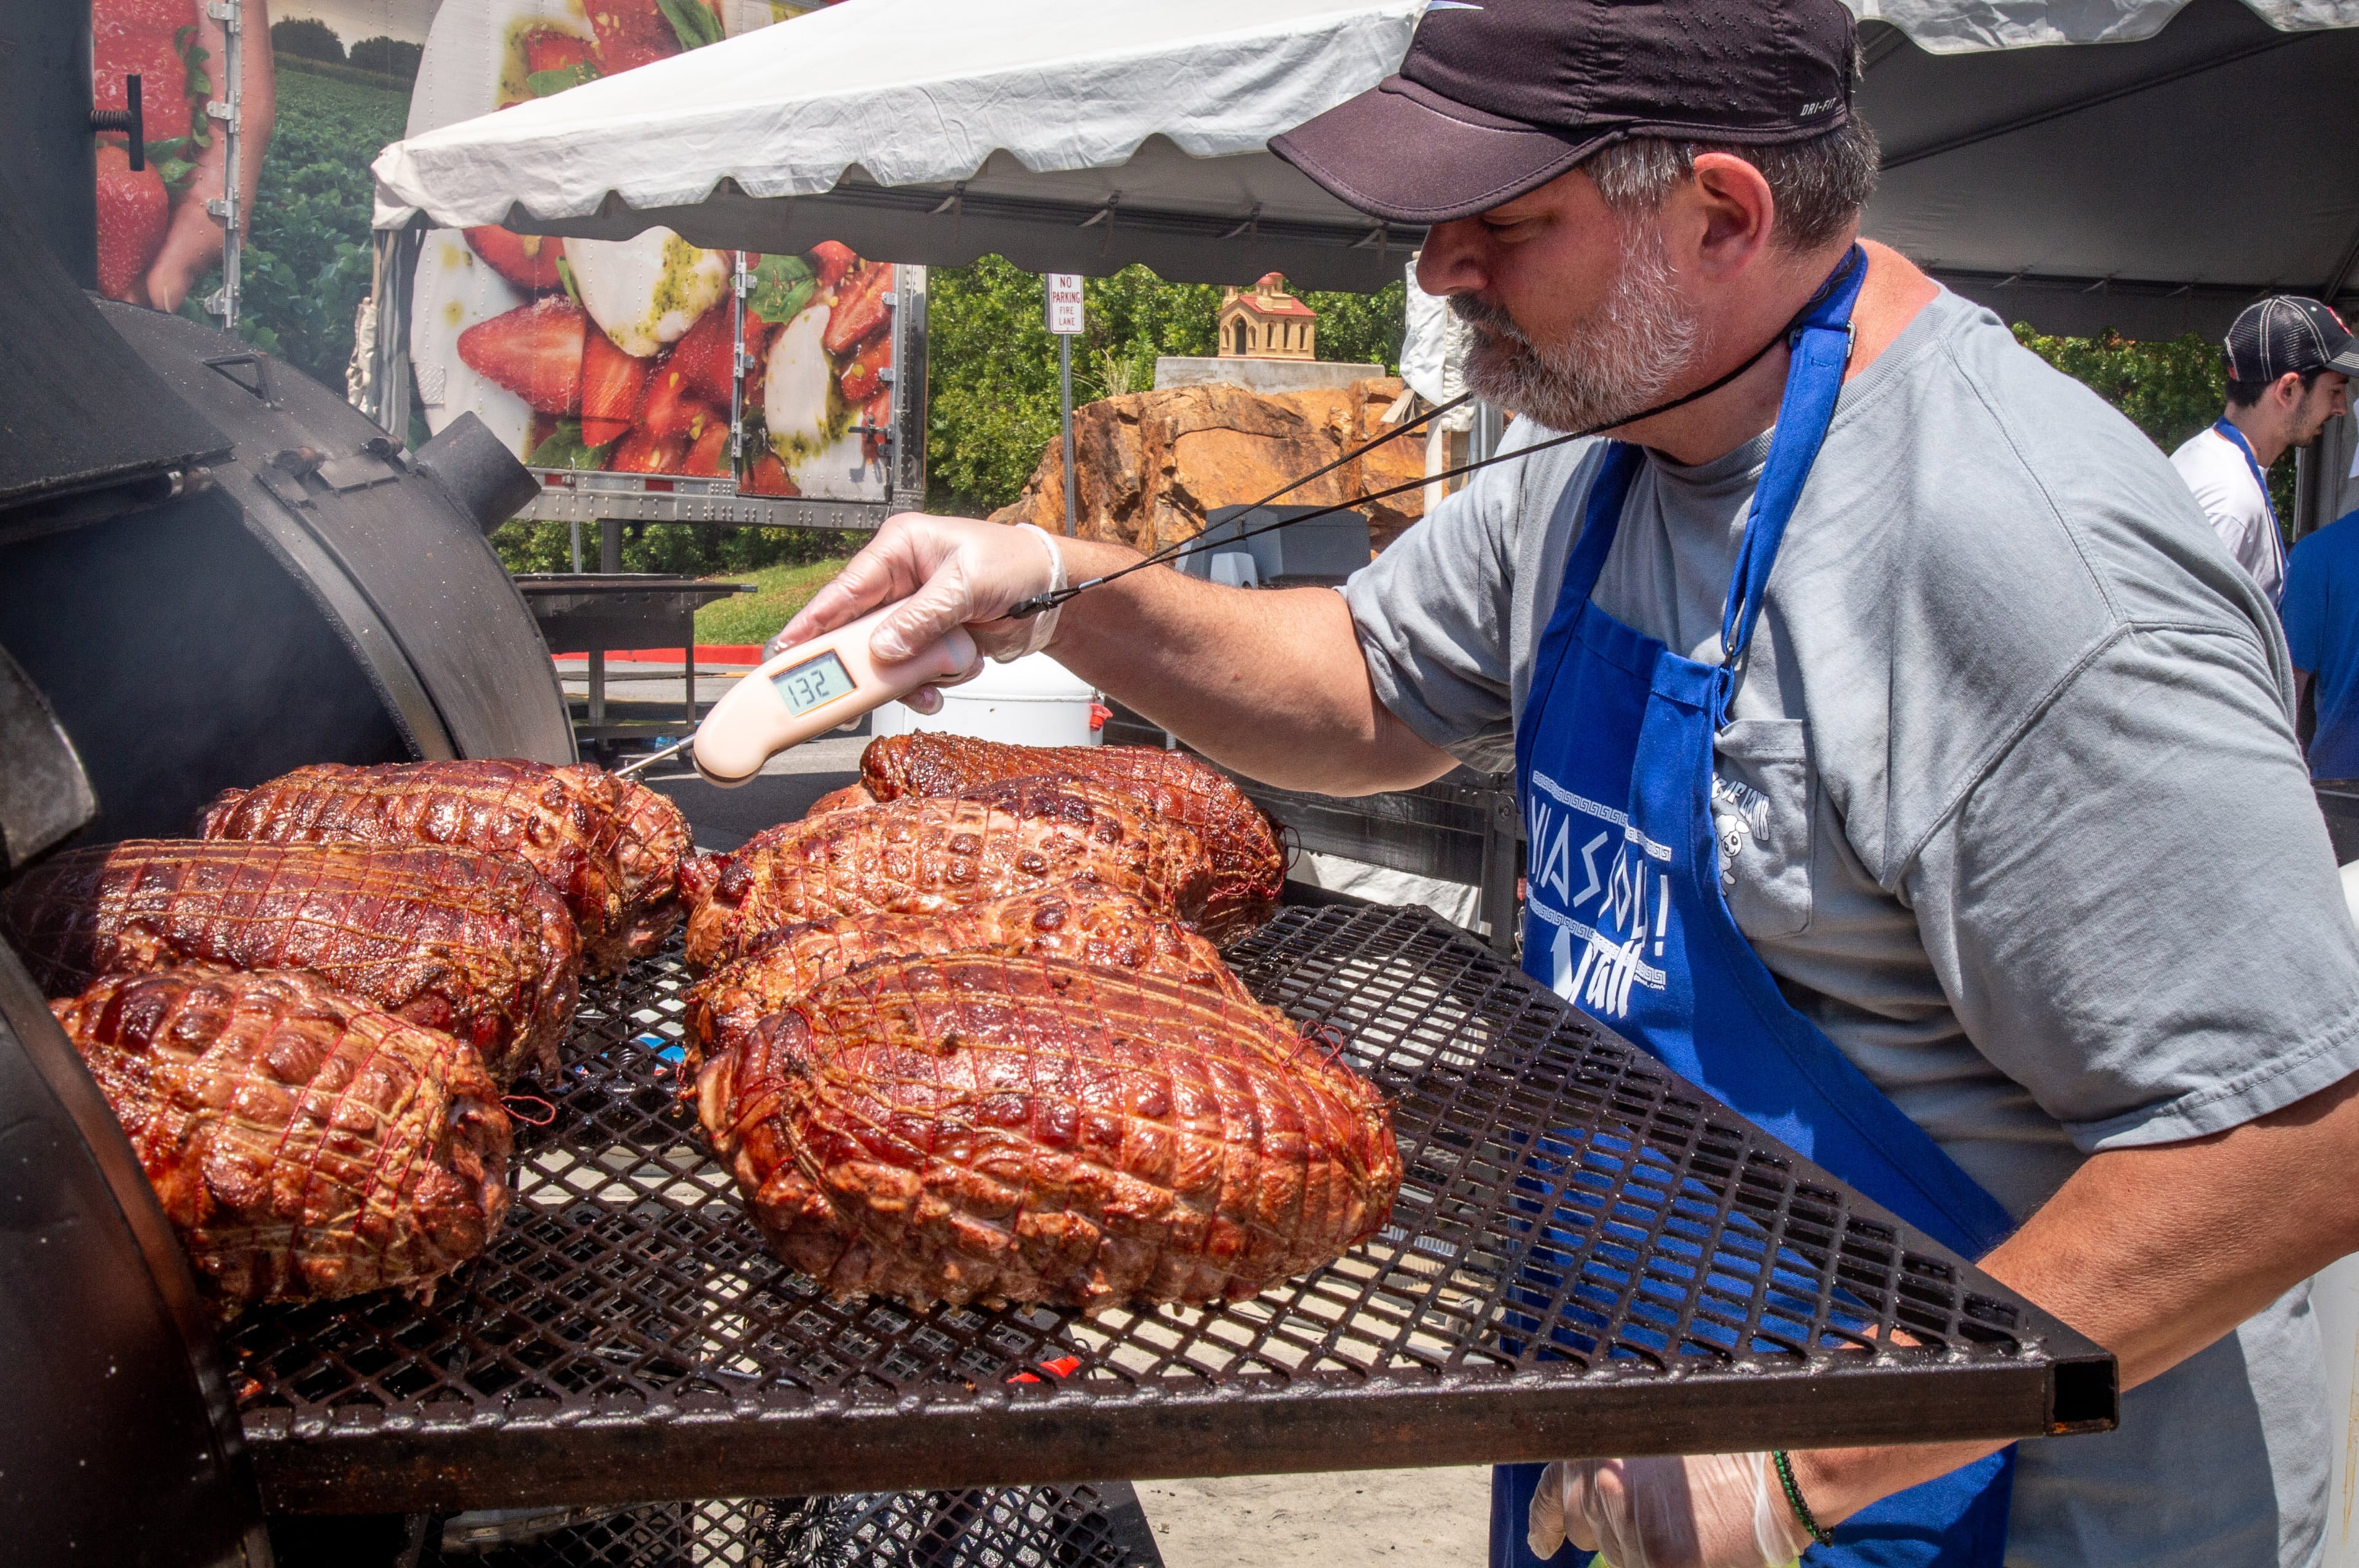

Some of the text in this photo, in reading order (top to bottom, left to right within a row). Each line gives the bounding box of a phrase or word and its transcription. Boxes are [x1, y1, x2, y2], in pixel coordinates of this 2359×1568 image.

[1800, 97, 1837, 116] DRI-FIT
[1060, 276, 1071, 288] NO
[1052, 292, 1080, 303] PARKING
[1060, 306, 1074, 315] FIRE
[1059, 318, 1075, 326] LANE
[788, 669, 830, 708] 132
